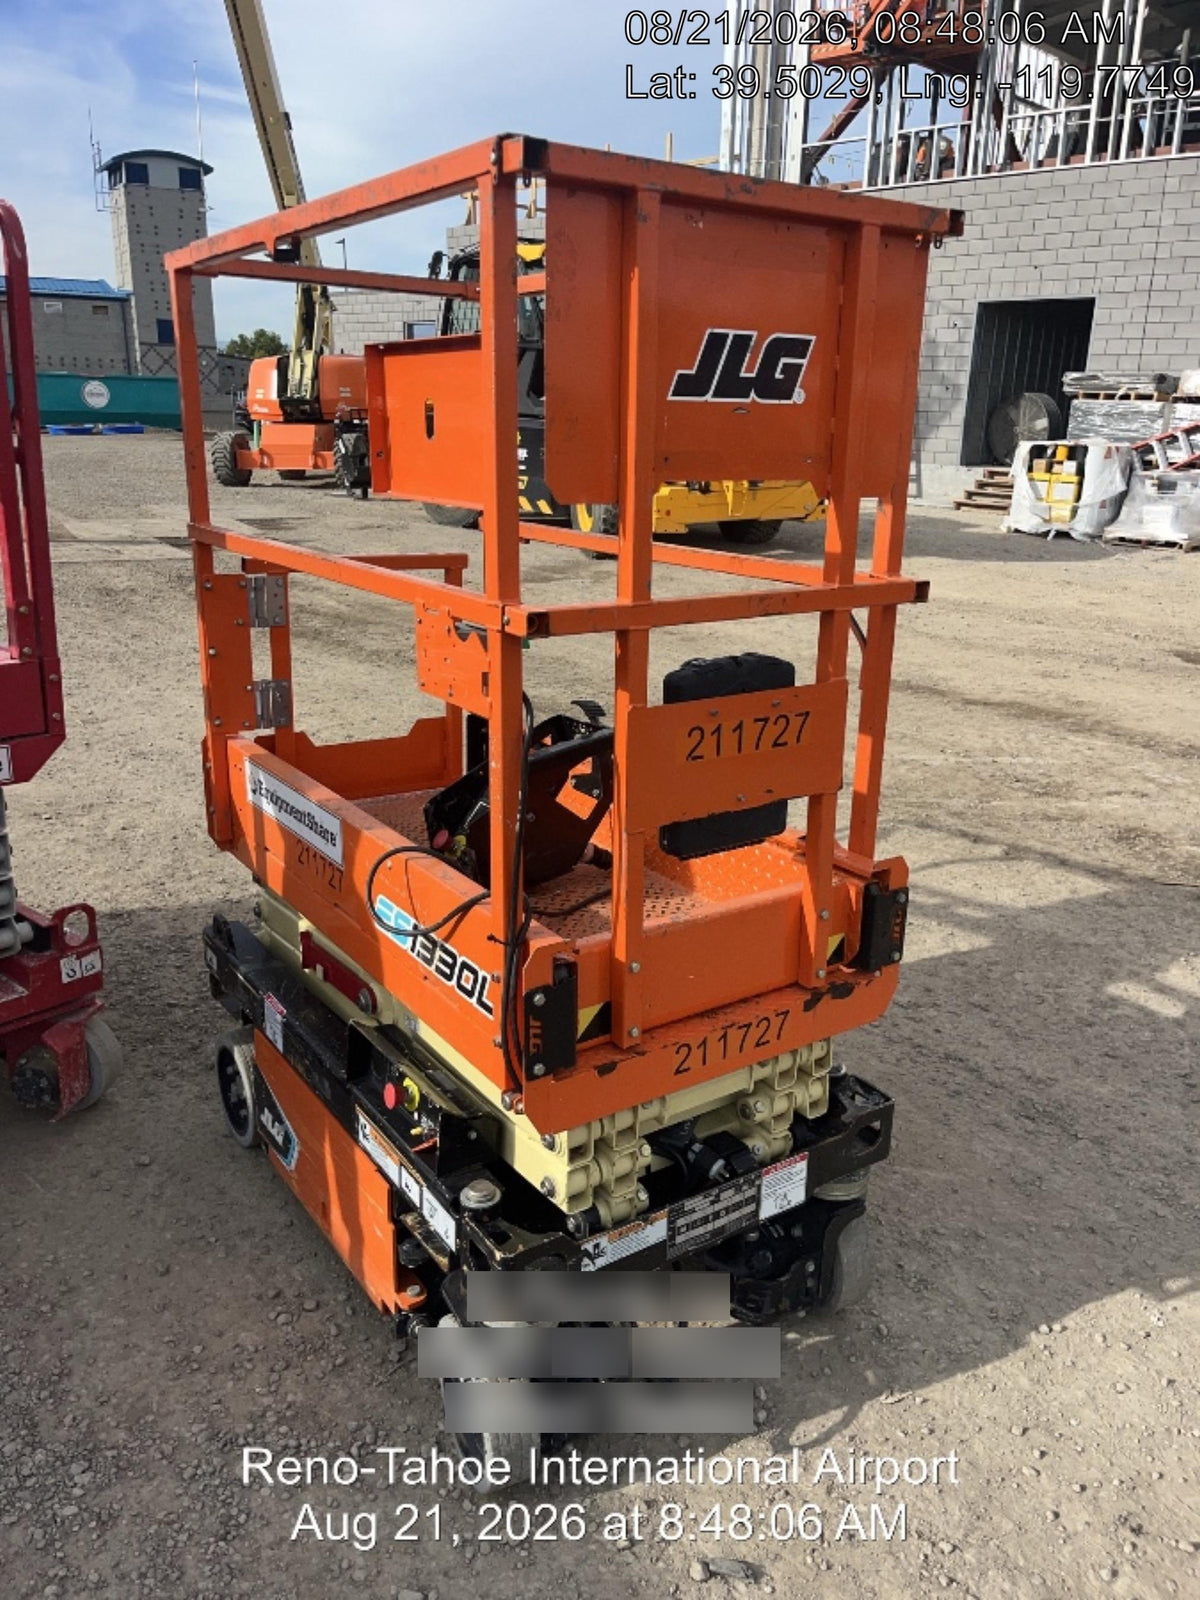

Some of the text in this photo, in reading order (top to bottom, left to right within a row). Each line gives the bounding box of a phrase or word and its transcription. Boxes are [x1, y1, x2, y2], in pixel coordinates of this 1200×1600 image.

[686, 710, 811, 761] 211727
[529, 1015, 543, 1057] JLG
[673, 1009, 791, 1076] 211727
